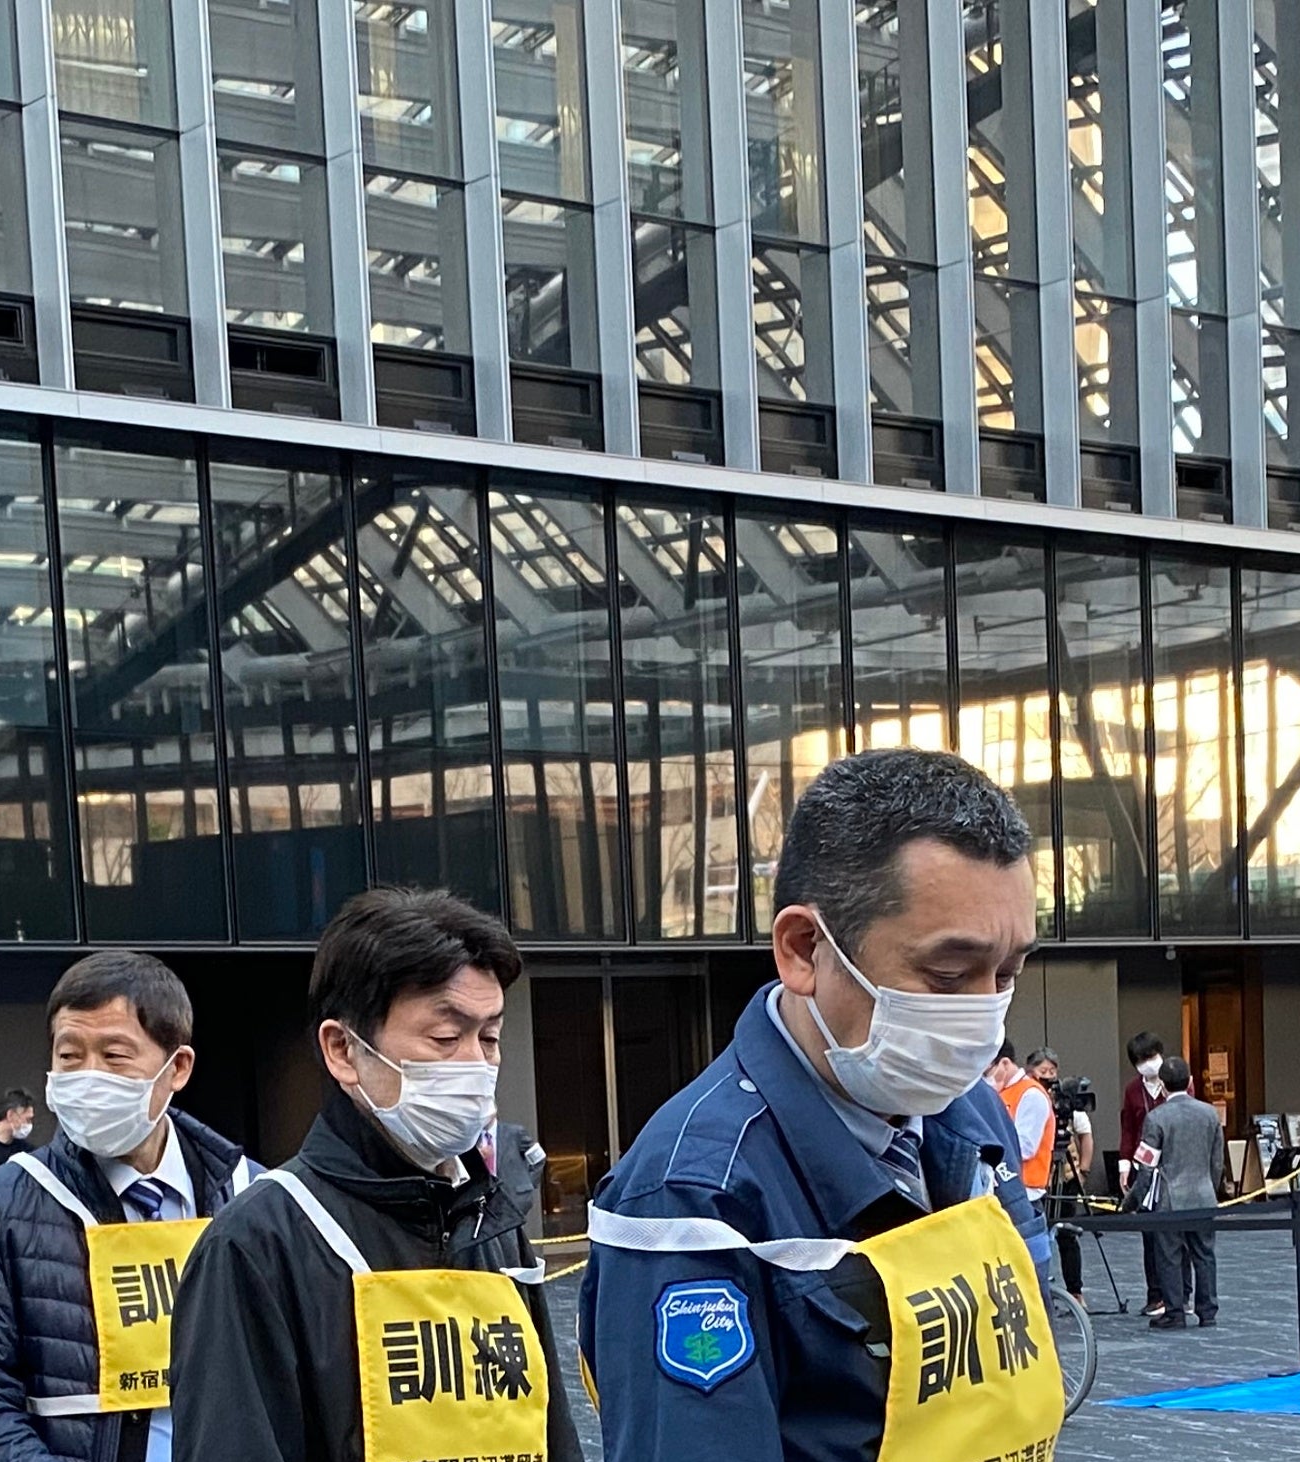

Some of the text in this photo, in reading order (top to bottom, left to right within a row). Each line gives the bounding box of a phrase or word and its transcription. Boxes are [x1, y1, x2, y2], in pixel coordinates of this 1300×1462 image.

[668, 1298, 735, 1317] Shinjuku
[701, 1313, 734, 1331] City
[906, 1256, 1038, 1405] 訓練
[382, 1315, 533, 1405] 訓練
